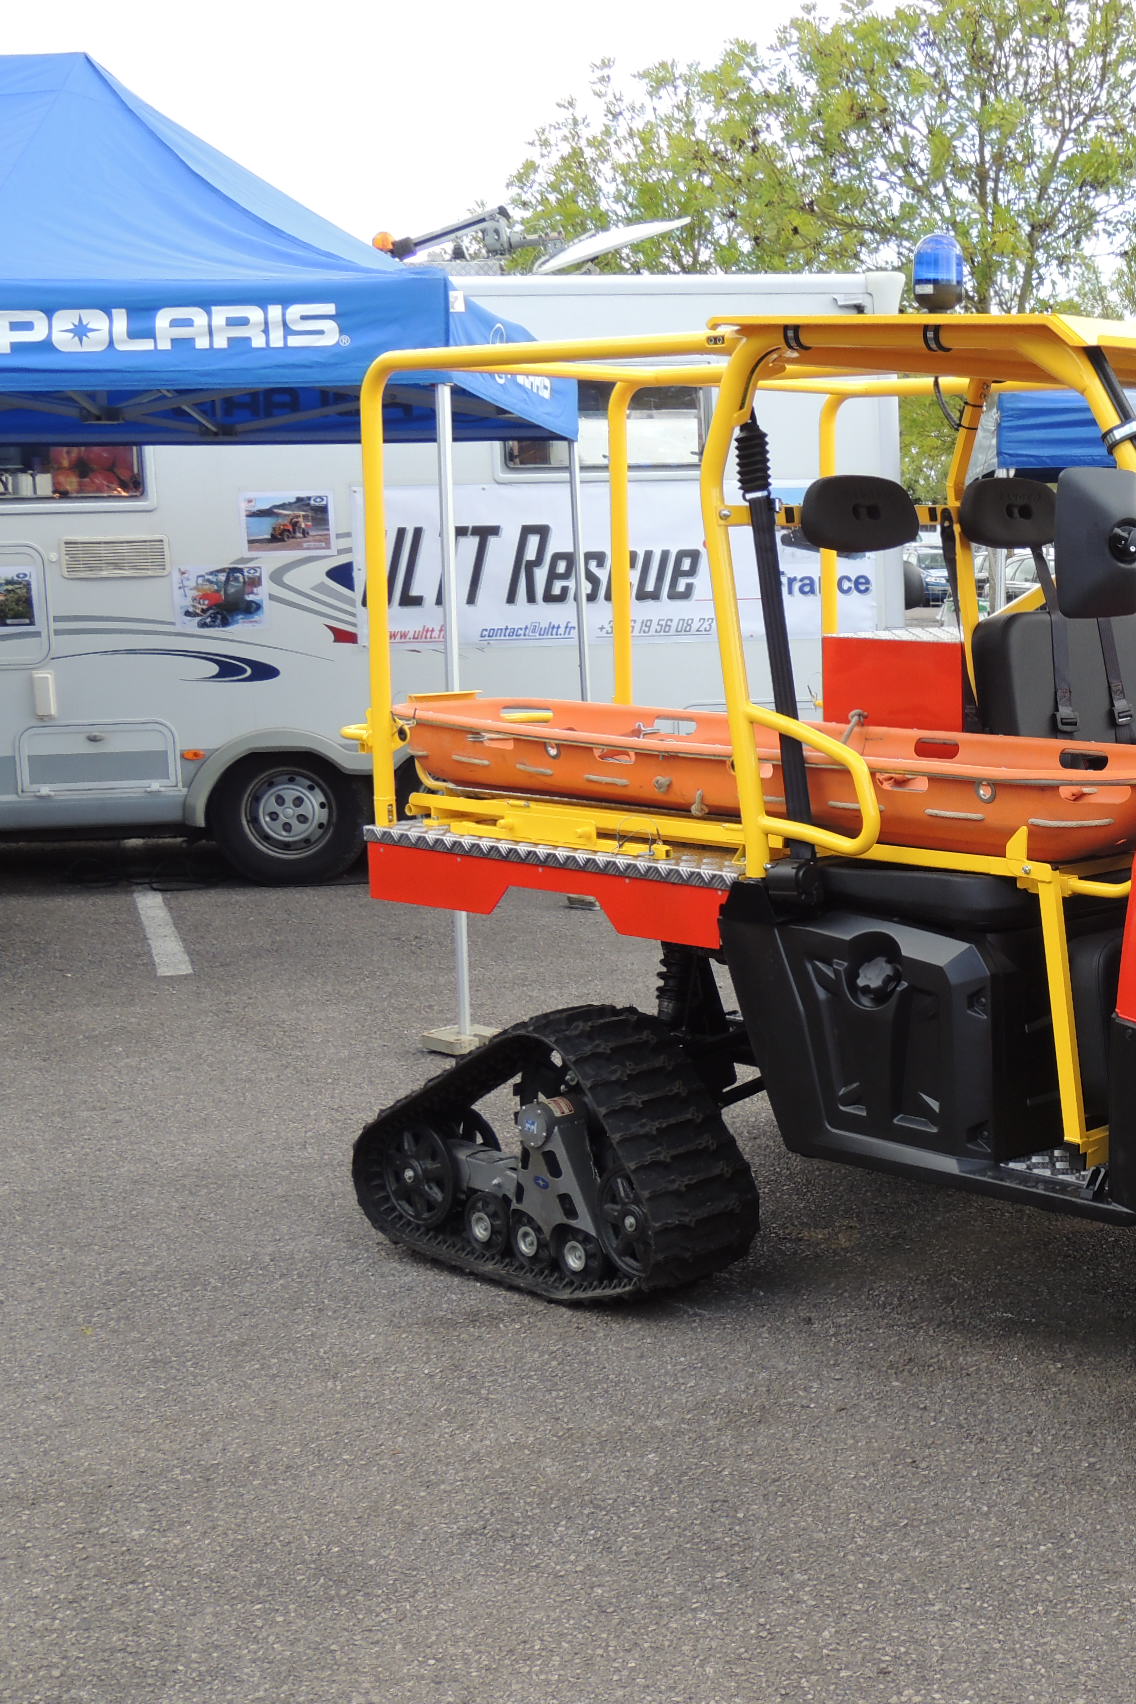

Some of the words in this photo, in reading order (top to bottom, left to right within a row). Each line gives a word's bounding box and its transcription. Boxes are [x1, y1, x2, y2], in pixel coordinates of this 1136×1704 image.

[0, 303, 341, 353] POLARIS
[779, 571, 871, 596] race
[389, 624, 446, 641] ww.ultt.f
[480, 621, 576, 639] contact@ultt.fr
[638, 618, 653, 635] 19
[655, 618, 673, 634] 56
[675, 617, 694, 633] 08
[696, 617, 714, 633] 23
